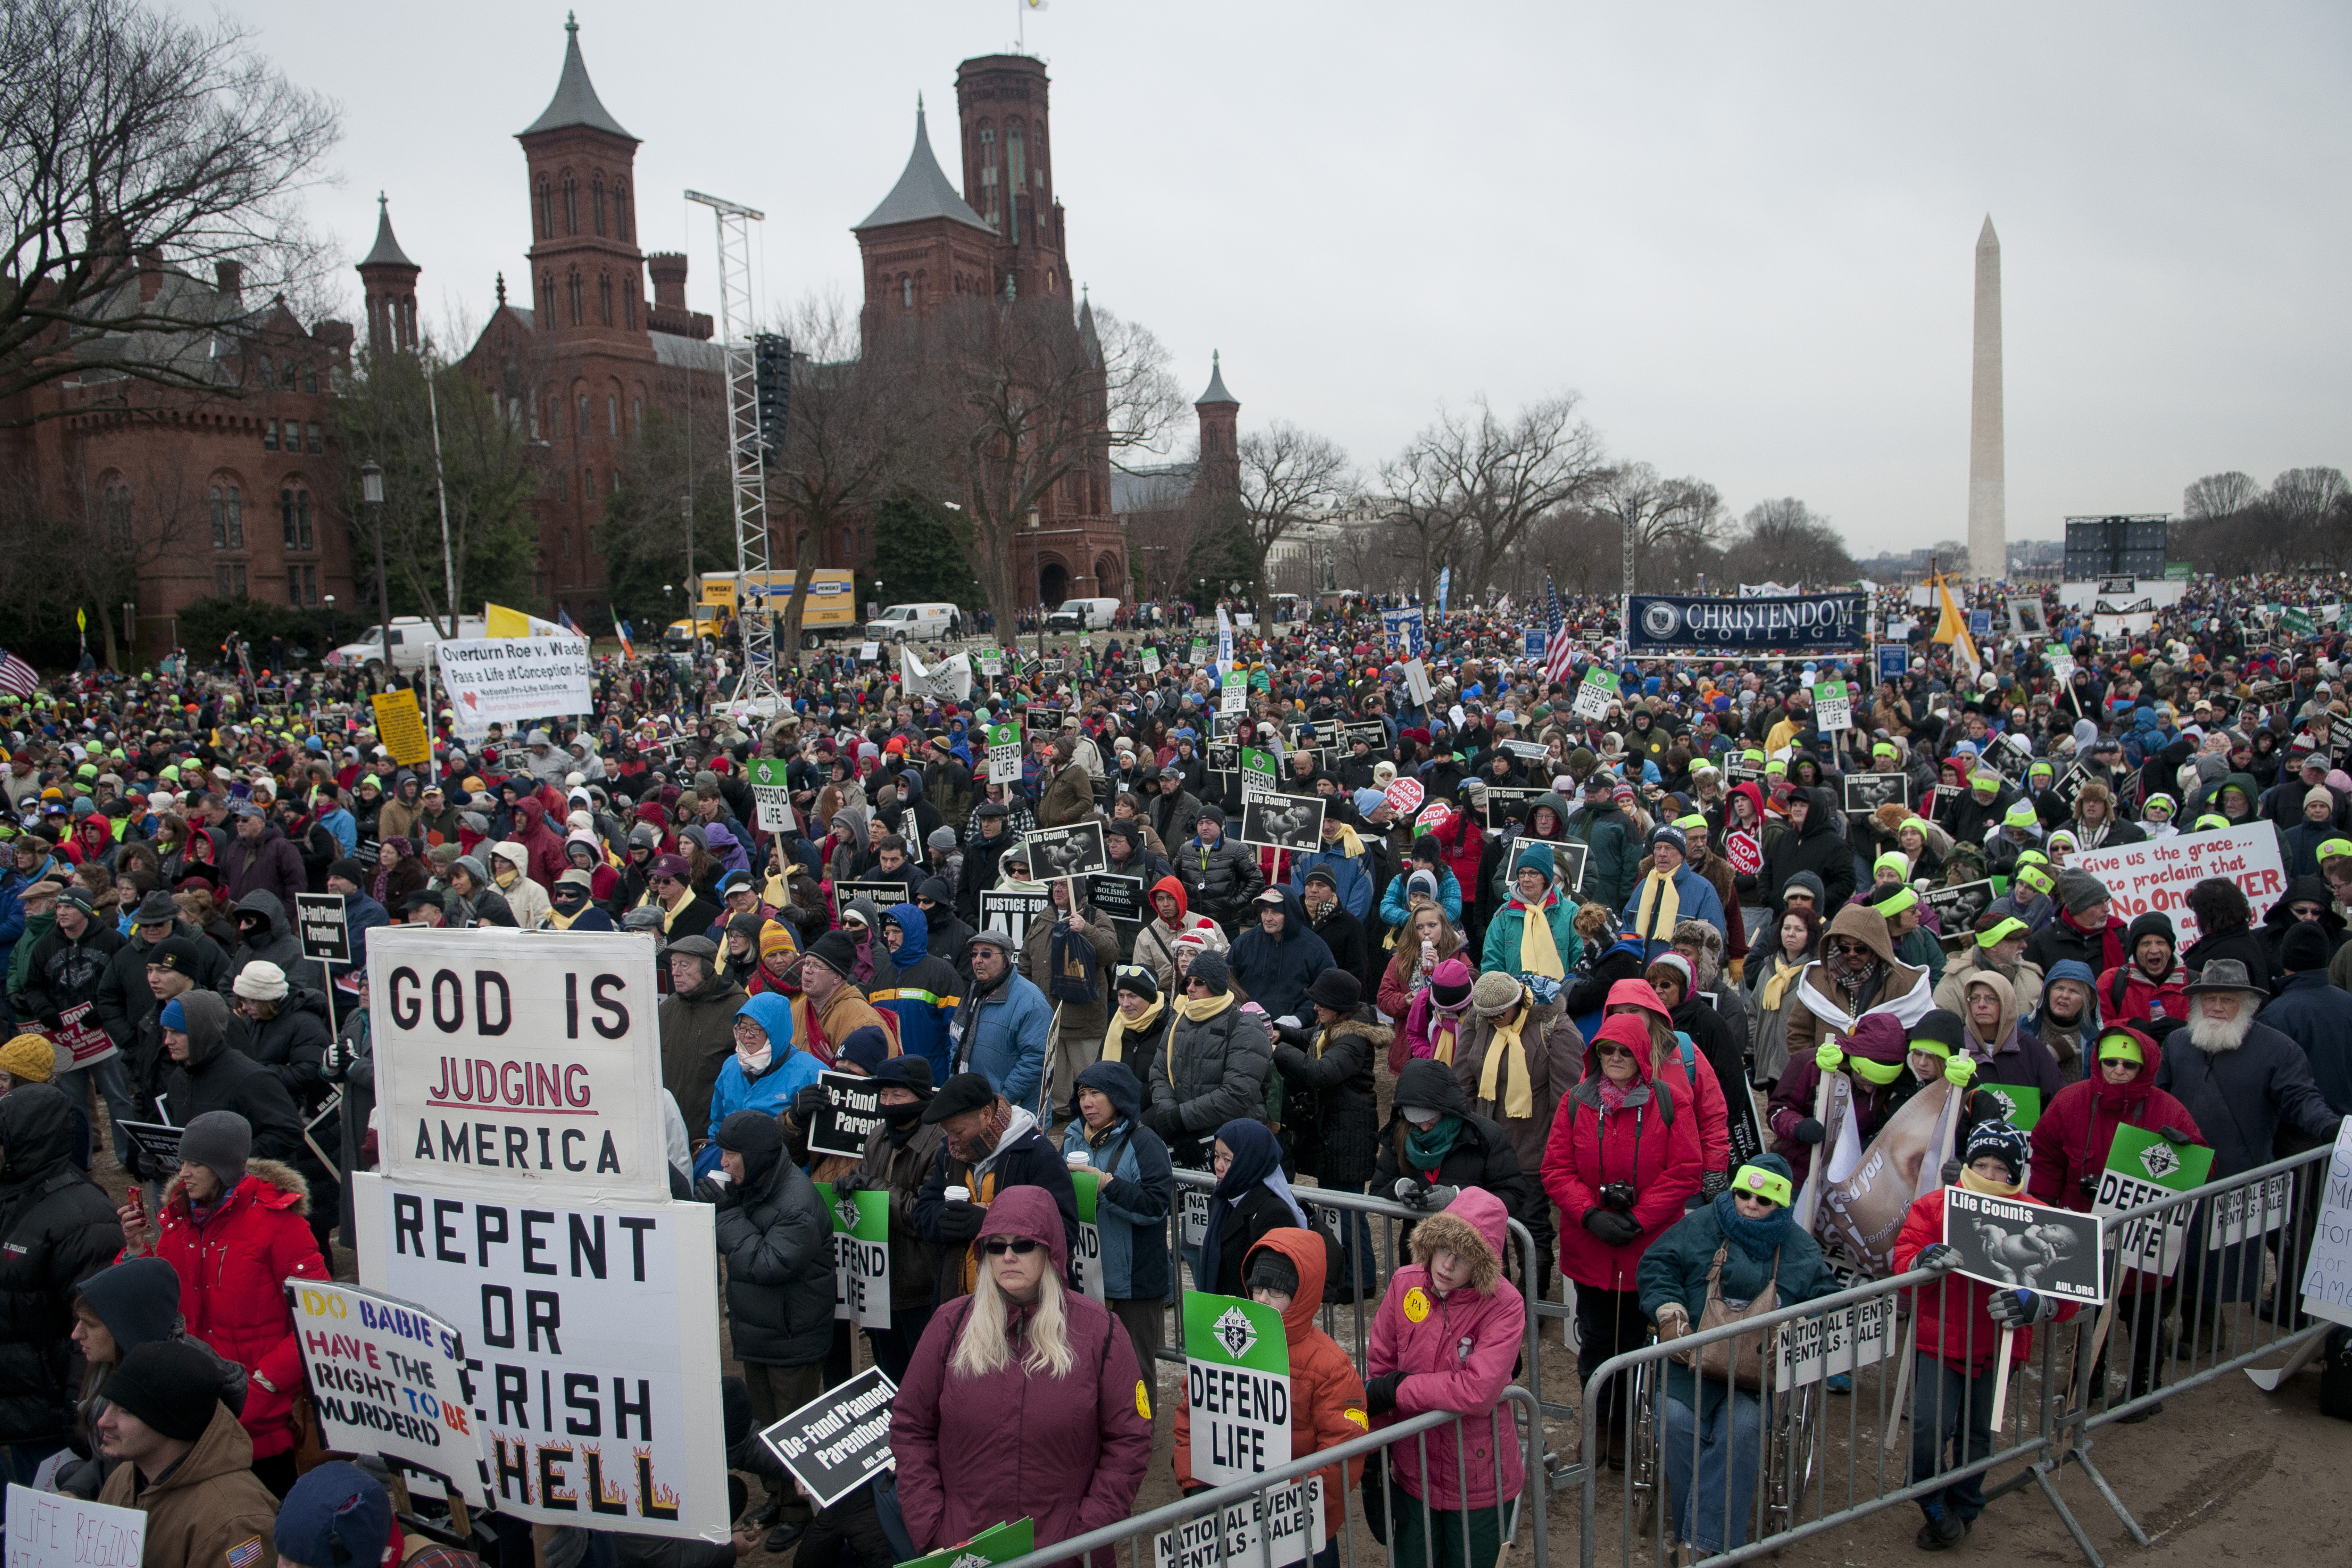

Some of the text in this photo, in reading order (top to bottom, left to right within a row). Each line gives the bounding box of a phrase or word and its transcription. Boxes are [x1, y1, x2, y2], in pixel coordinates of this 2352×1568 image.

[1686, 600, 1854, 629] CHRISTENDOM
[443, 642, 584, 661] Overturn Roe v. Wade
[451, 669, 474, 683] Pass
[477, 673, 484, 682] a
[484, 667, 504, 681] Life
[508, 667, 517, 680] at
[518, 664, 572, 680] Conception
[480, 687, 510, 695] National
[539, 683, 568, 692] Alliance
[1223, 687, 1246, 698] DEFEND
[1580, 683, 1610, 702] DEFEND
[1228, 698, 1240, 708] LIFE
[1582, 698, 1599, 713] LIFE
[1818, 698, 1848, 713] DEFEND
[1826, 713, 1842, 725] LIFE
[990, 744, 1020, 762] DEFEND
[998, 760, 1014, 777] LIFE
[1243, 769, 1275, 790] DEFEND
[1399, 780, 1420, 797] STOP
[754, 786, 788, 805] DEFEND
[1249, 793, 1291, 808] Life Counts
[1387, 794, 1409, 811] NOW
[1390, 784, 1419, 806] ABORTION
[1502, 790, 1524, 799] Counts
[764, 806, 783, 824] LIFE
[1423, 808, 1445, 820] STOP
[1028, 830, 1069, 843] Life Counts
[1296, 840, 1316, 849] AUL.ORG
[1516, 840, 1530, 850] Life
[1732, 837, 1757, 859] STOP
[2126, 852, 2146, 866] us
[2152, 846, 2180, 862] the
[2106, 855, 2247, 893] to proclaim that
[839, 888, 905, 901] De-Fund Planned
[1100, 881, 1127, 890] courageously
[985, 897, 1049, 912] JUSTICE FOR
[1095, 894, 1131, 904] ABORTION
[1931, 890, 1960, 902] Counts
[298, 904, 344, 923] De-Fund Planned
[2111, 895, 2147, 917] No
[307, 924, 342, 942] Parenthood
[988, 912, 1039, 949] AL
[389, 966, 630, 1039] GOD IS
[81, 1029, 103, 1041] Matter
[86, 1033, 106, 1045] Small
[430, 1056, 591, 1108] JUDGING
[317, 1092, 339, 1112] AUL.ORG
[414, 1117, 621, 1174] AMERICA
[1859, 1151, 1884, 1192] you
[1951, 1191, 2034, 1223] Life Counts
[393, 1192, 656, 1282] REPENT
[1865, 1217, 1900, 1244] remiah
[2122, 1220, 2162, 1258] IFE
[834, 1237, 885, 1277] EFEND
[2055, 1280, 2095, 1296] AUL.ORG
[302, 1289, 347, 1319] DO
[1411, 1298, 1421, 1312] PA
[481, 1283, 562, 1355] OR
[1781, 1315, 1842, 1348] NTIOAL
[305, 1330, 437, 1390] HAVE THE
[314, 1362, 470, 1436] RIGHT TO BE
[465, 1358, 653, 1441] ERISH
[1190, 1363, 1287, 1425] DEFEND
[315, 1394, 441, 1447] MURDERD
[778, 1380, 896, 1459] De-Fund Planned
[813, 1408, 893, 1470] Parenthood
[1212, 1421, 1265, 1473] LIFE
[52, 1455, 61, 1470] Wade
[861, 1446, 892, 1470] AUL.ORG
[492, 1437, 680, 1521] HELL
[15, 1490, 139, 1567] LIFE BEGINS
[1160, 1507, 1248, 1557] NTIOAL
